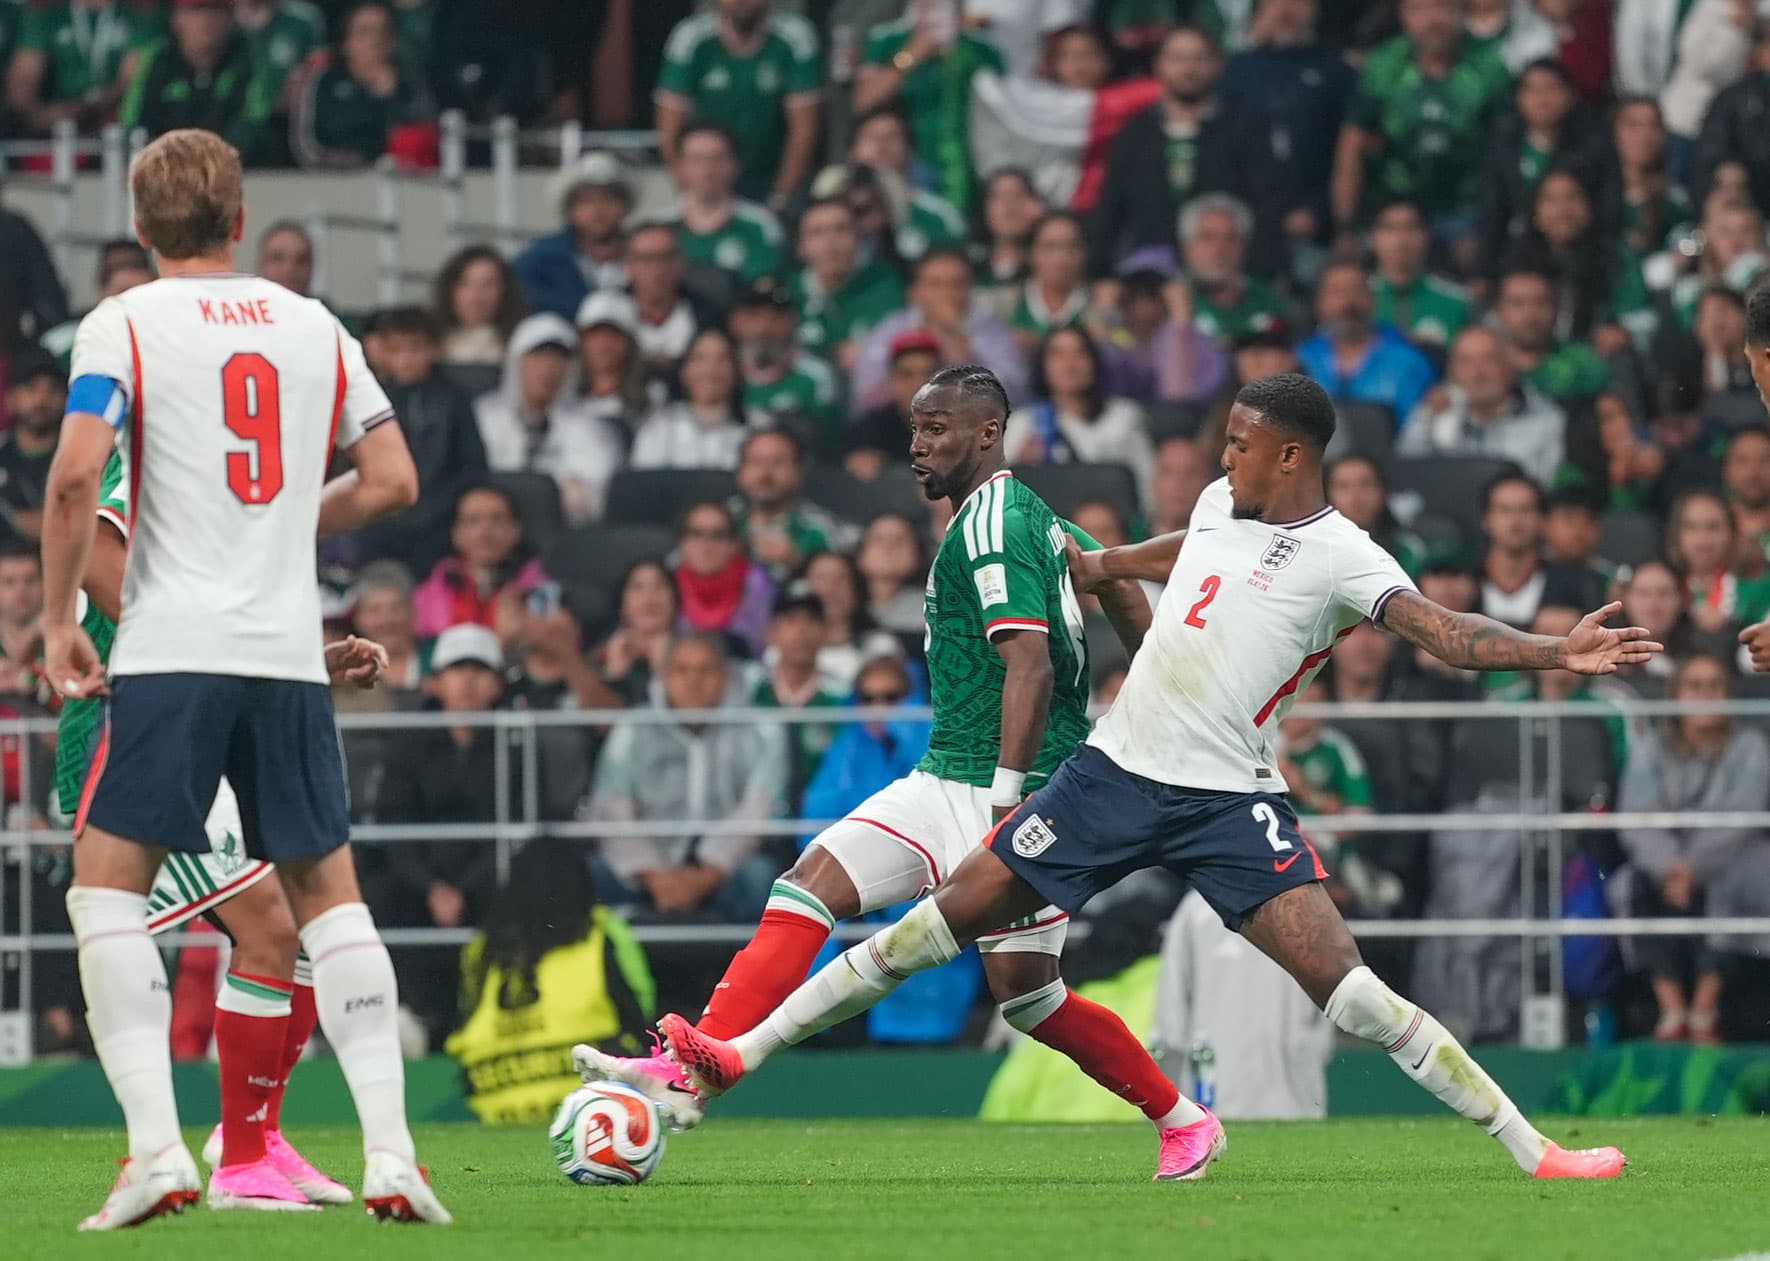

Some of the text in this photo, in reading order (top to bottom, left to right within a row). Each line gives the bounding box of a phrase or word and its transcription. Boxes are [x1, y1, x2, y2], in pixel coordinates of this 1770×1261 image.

[199, 299, 275, 325] KANE
[221, 352, 284, 505] 9
[1184, 574, 1221, 629] 2
[1251, 802, 1293, 852] 2
[344, 995, 384, 1014] ENG
[468, 1047, 577, 1091] SECURIT
